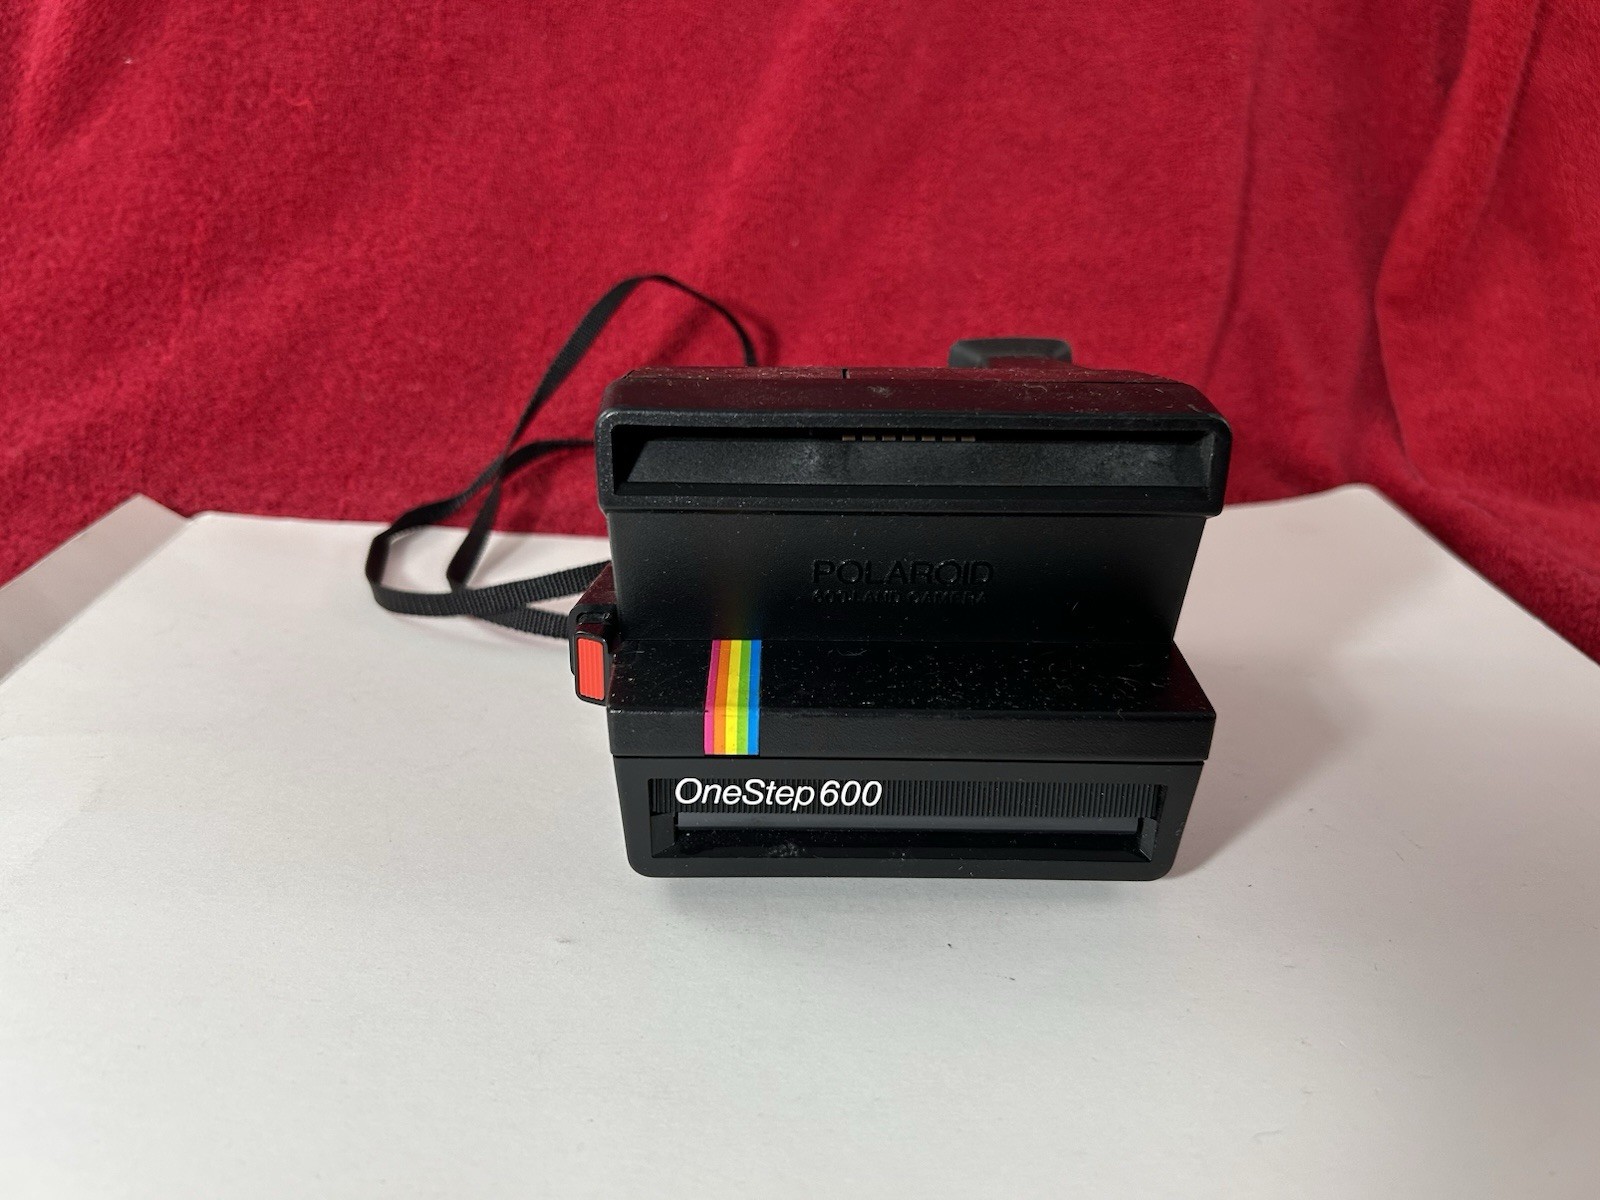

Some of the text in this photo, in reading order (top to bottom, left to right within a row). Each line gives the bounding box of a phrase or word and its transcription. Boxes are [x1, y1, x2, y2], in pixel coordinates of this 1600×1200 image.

[812, 559, 995, 585] POLAROID
[674, 777, 883, 811] OneStep 600
